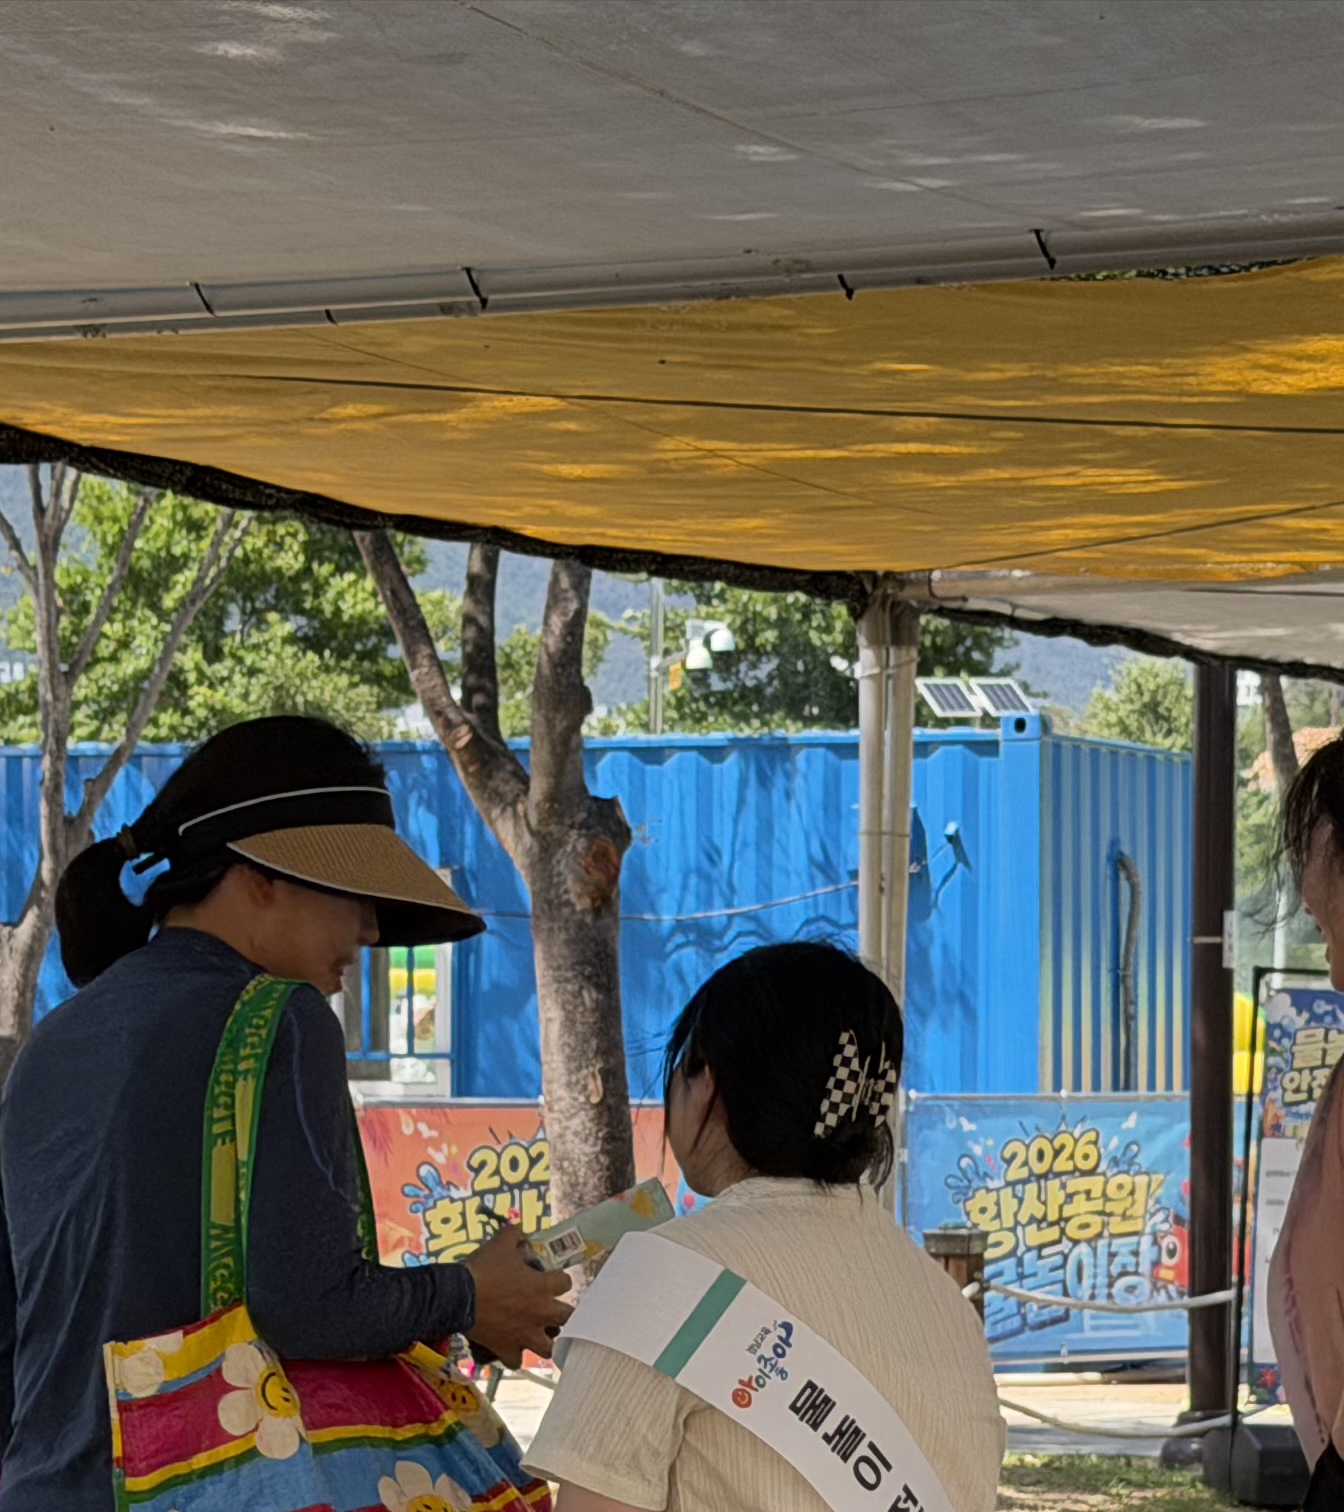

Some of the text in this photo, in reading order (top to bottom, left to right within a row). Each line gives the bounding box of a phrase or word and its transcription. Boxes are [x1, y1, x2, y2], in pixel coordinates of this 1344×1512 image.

[469, 1141, 551, 1191] 202
[1002, 1129, 1099, 1182] 2026
[964, 1173, 1150, 1261] 황산공원
[983, 1235, 1159, 1339] 물놀이장
[731, 1320, 794, 1409] 아이좋아
[788, 1378, 893, 1492] 물놀이
